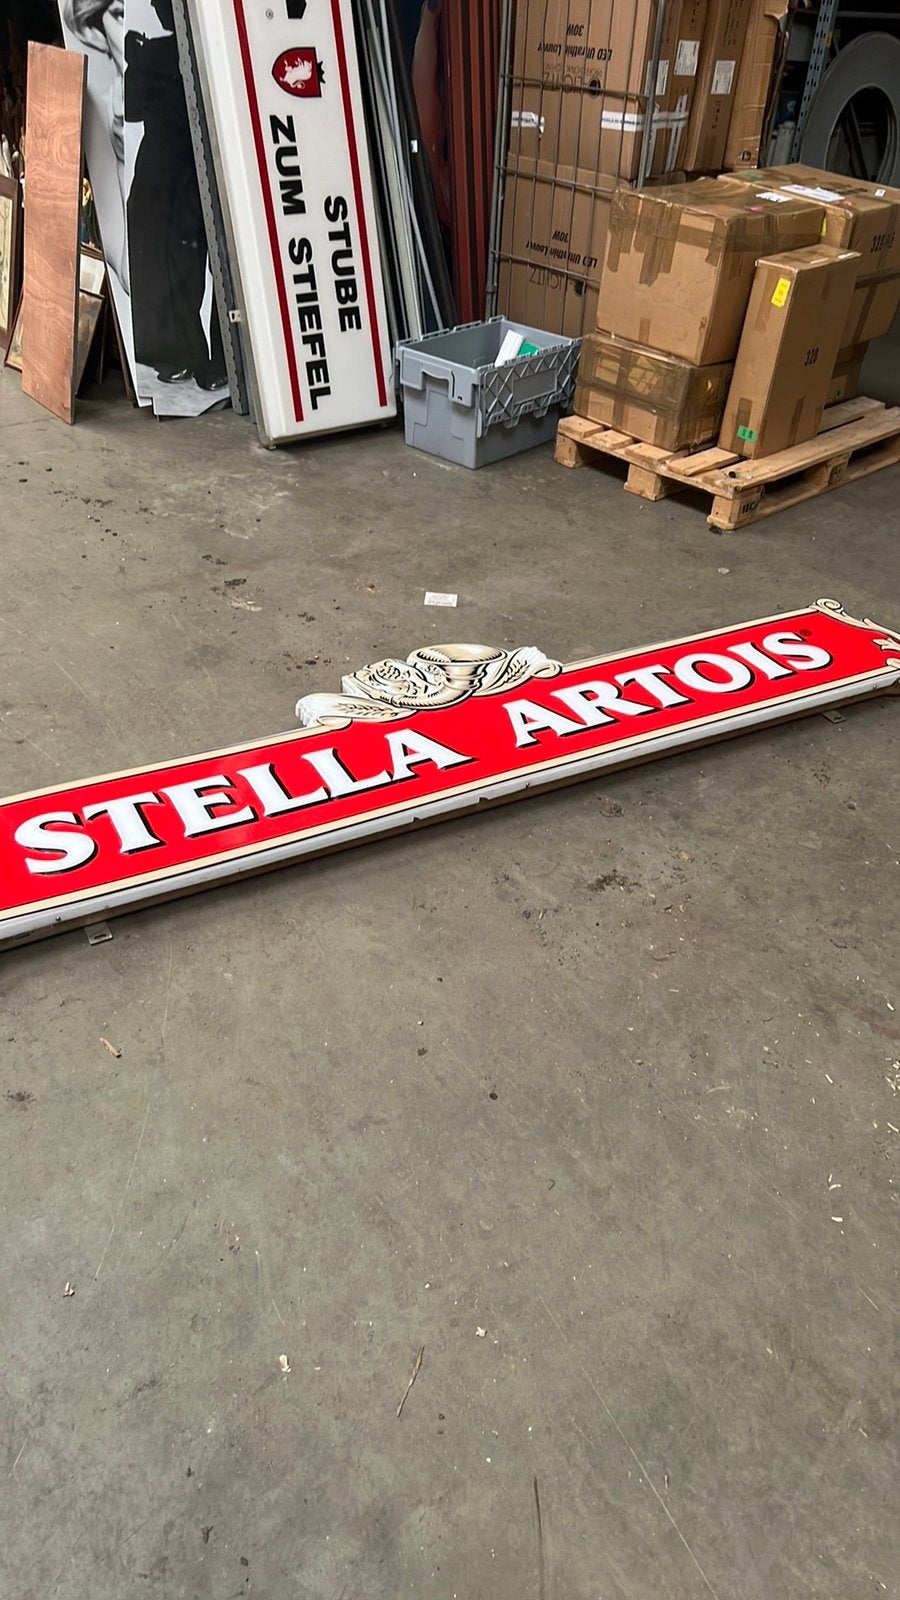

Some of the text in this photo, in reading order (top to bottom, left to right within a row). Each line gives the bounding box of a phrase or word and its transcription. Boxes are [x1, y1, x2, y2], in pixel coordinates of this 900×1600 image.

[269, 114, 332, 411] ZUM STIEFEL
[324, 195, 362, 333] STUBE
[14, 632, 833, 875] STELLA ARTOIS
